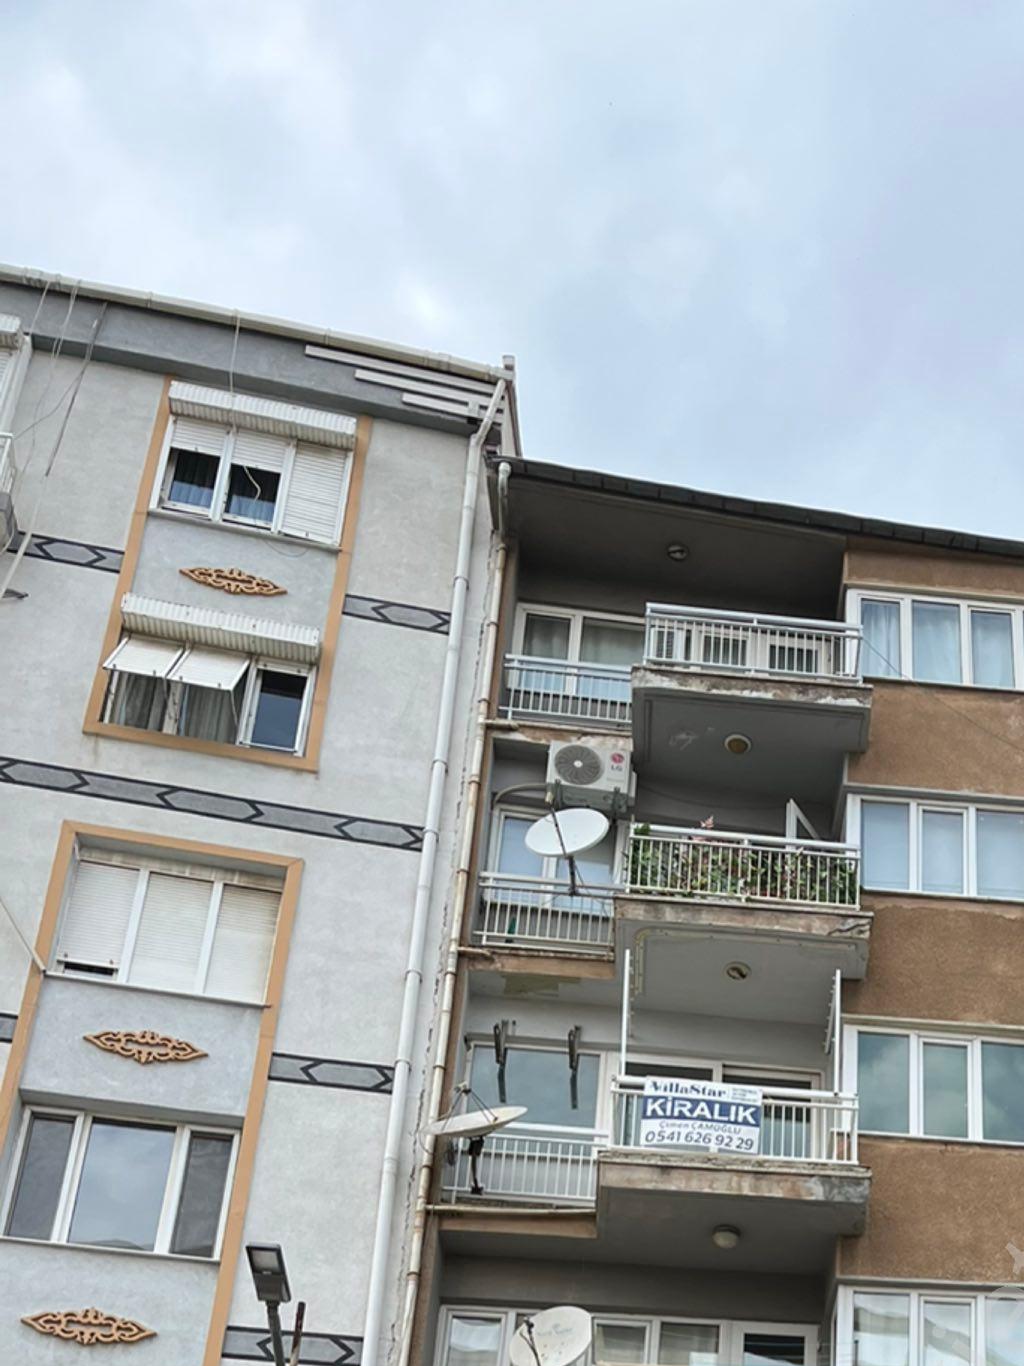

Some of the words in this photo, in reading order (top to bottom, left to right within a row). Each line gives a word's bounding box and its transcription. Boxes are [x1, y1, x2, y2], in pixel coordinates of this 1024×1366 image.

[651, 1081, 727, 1098] VillaStar
[645, 1095, 757, 1125] KİRALIK
[645, 1130, 681, 1143] 0541
[684, 1131, 712, 1145] 626
[715, 1134, 734, 1148] 92
[736, 1137, 754, 1151] 29
